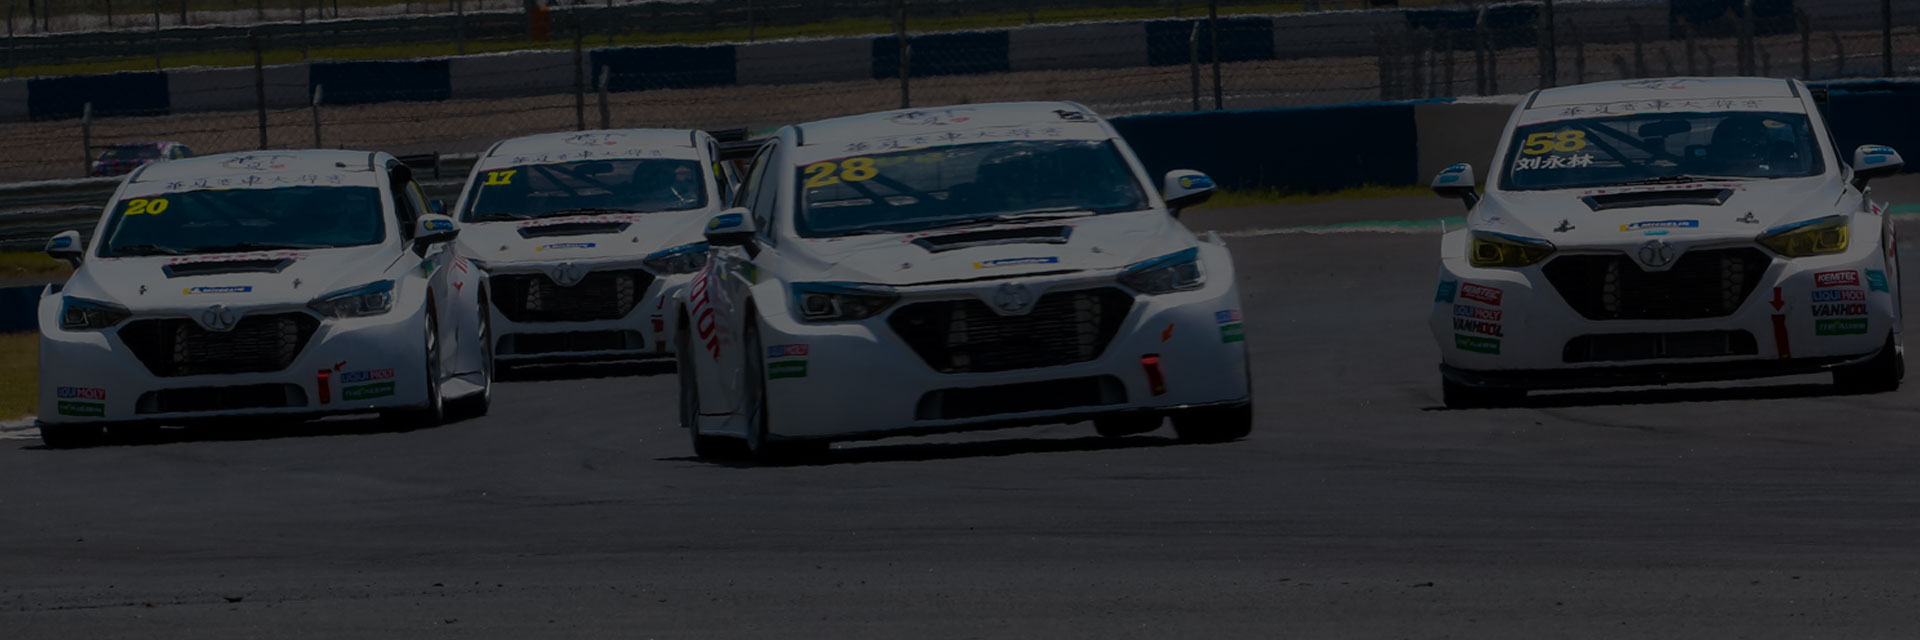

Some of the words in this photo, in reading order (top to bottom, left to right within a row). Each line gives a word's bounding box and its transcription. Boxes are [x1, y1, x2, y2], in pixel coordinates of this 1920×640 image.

[1523, 129, 1586, 155] 58
[1516, 153, 1594, 171] 刘永林
[485, 170, 517, 186] 17
[804, 157, 878, 189] 28
[125, 198, 168, 216] 20
[1812, 303, 1868, 317] VANHOOL
